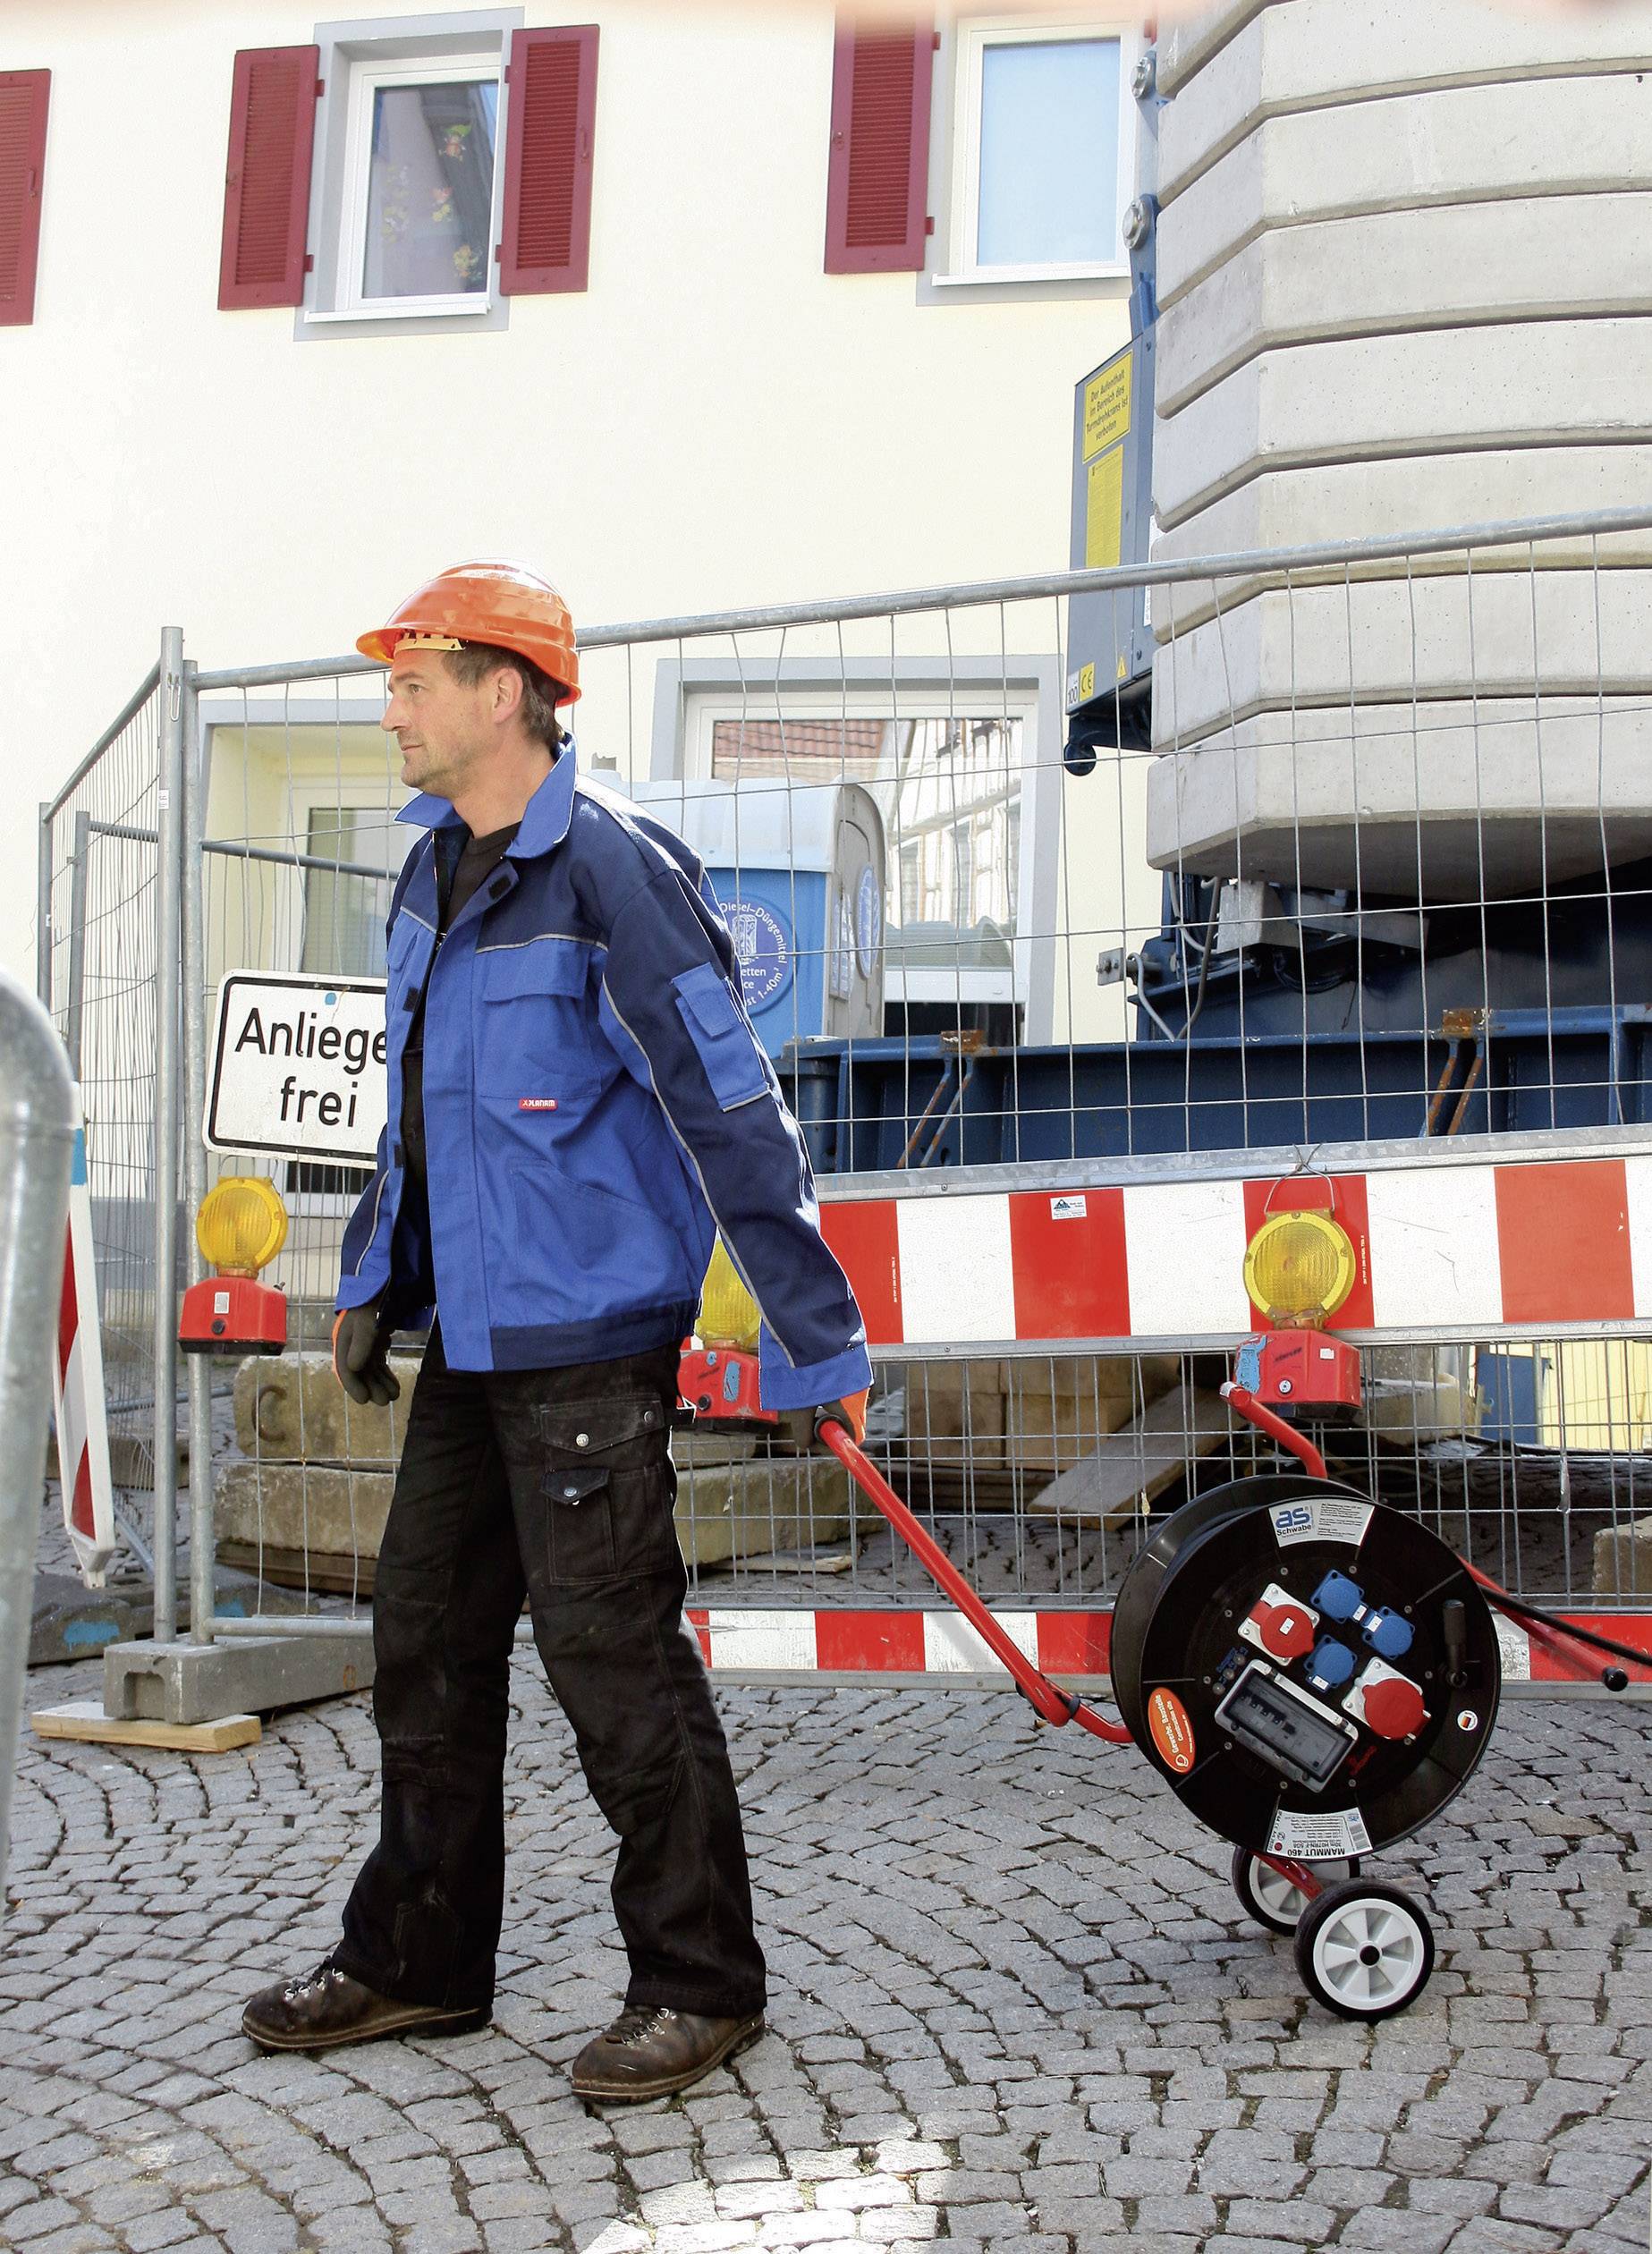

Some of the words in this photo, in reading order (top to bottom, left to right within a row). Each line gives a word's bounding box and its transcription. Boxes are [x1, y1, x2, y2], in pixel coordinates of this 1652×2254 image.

[1097, 392, 1115, 411] Bereich
[1096, 420, 1117, 440] verboten
[741, 967, 767, 977] etten
[235, 1007, 387, 1075] Anliege
[280, 1076, 358, 1128] frei
[1276, 1524, 1312, 1537] Schwabe
[1287, 1848, 1303, 1857] 460
[1304, 1847, 1345, 1856] MAMMUT
